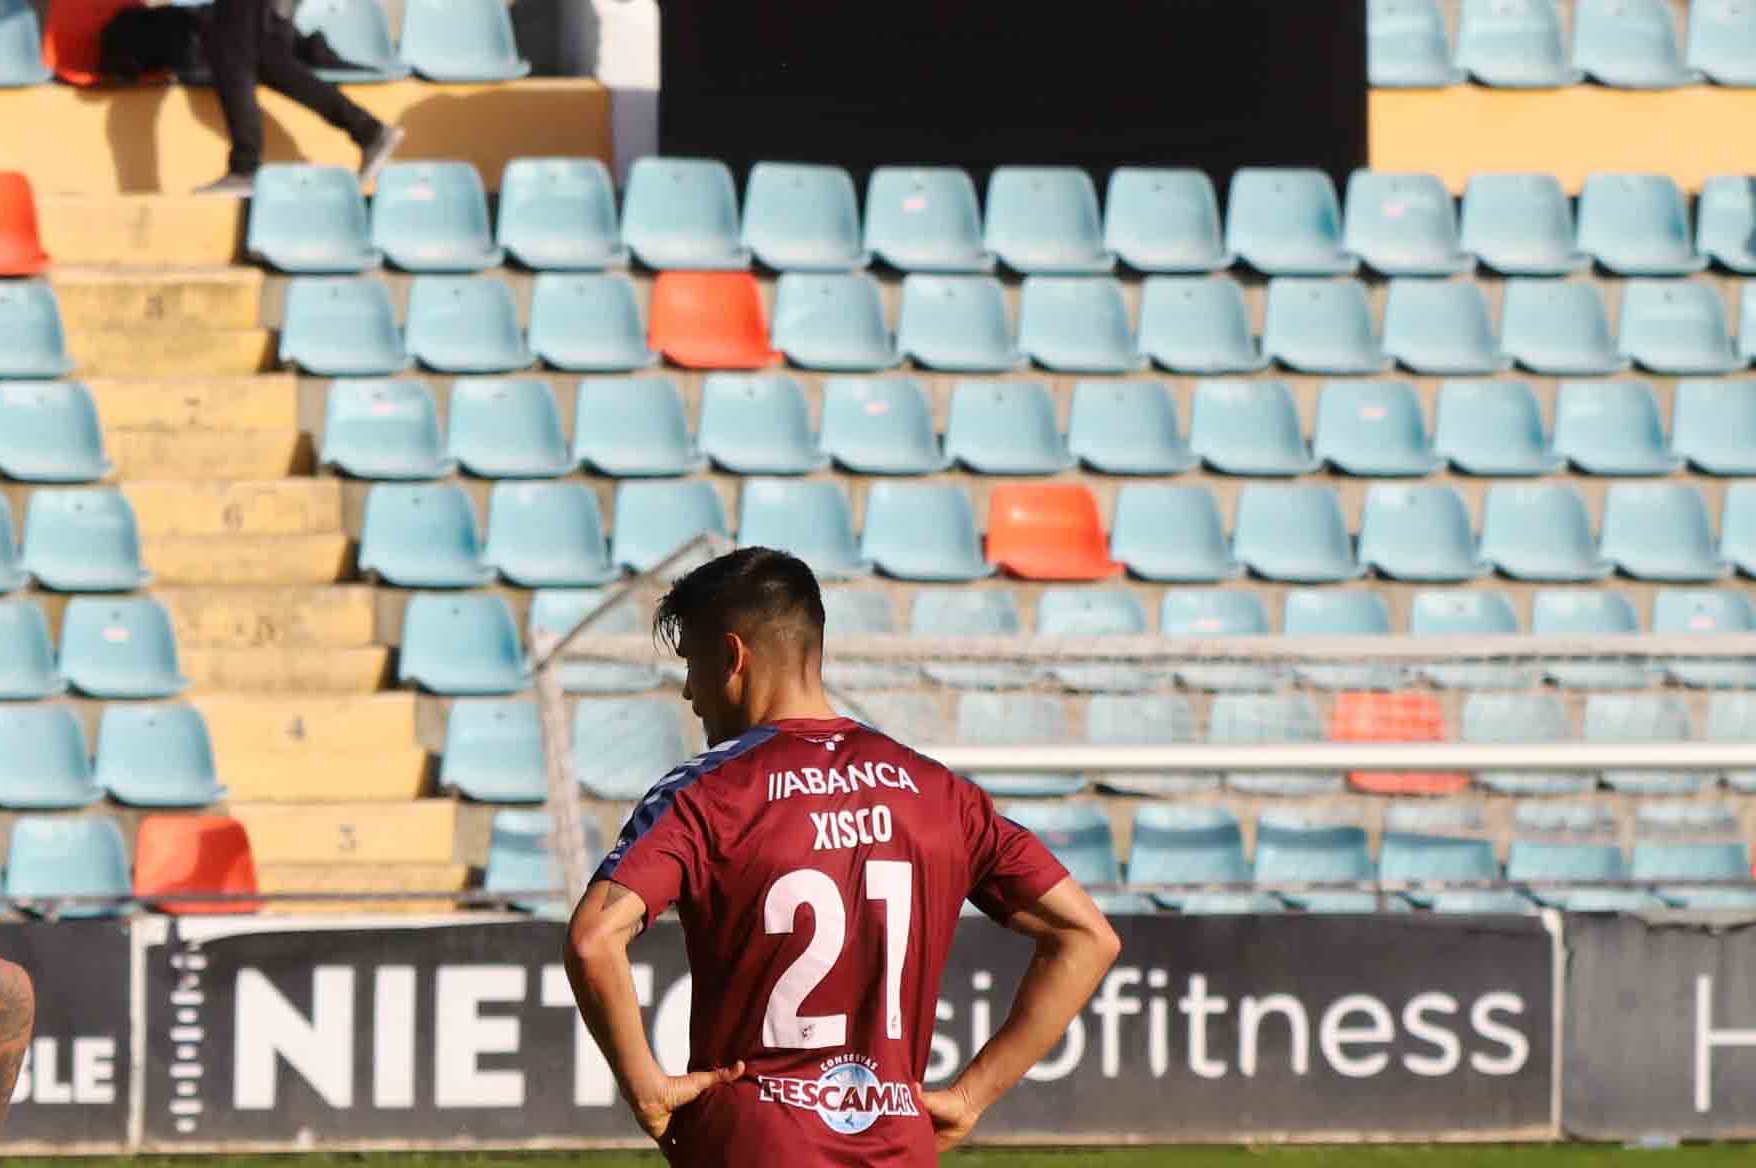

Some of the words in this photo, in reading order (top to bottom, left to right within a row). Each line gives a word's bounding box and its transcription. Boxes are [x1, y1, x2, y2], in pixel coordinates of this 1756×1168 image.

[810, 805, 892, 850] XISCO
[762, 860, 913, 1049] 21
[759, 1075, 920, 1117] PESCAMAR
